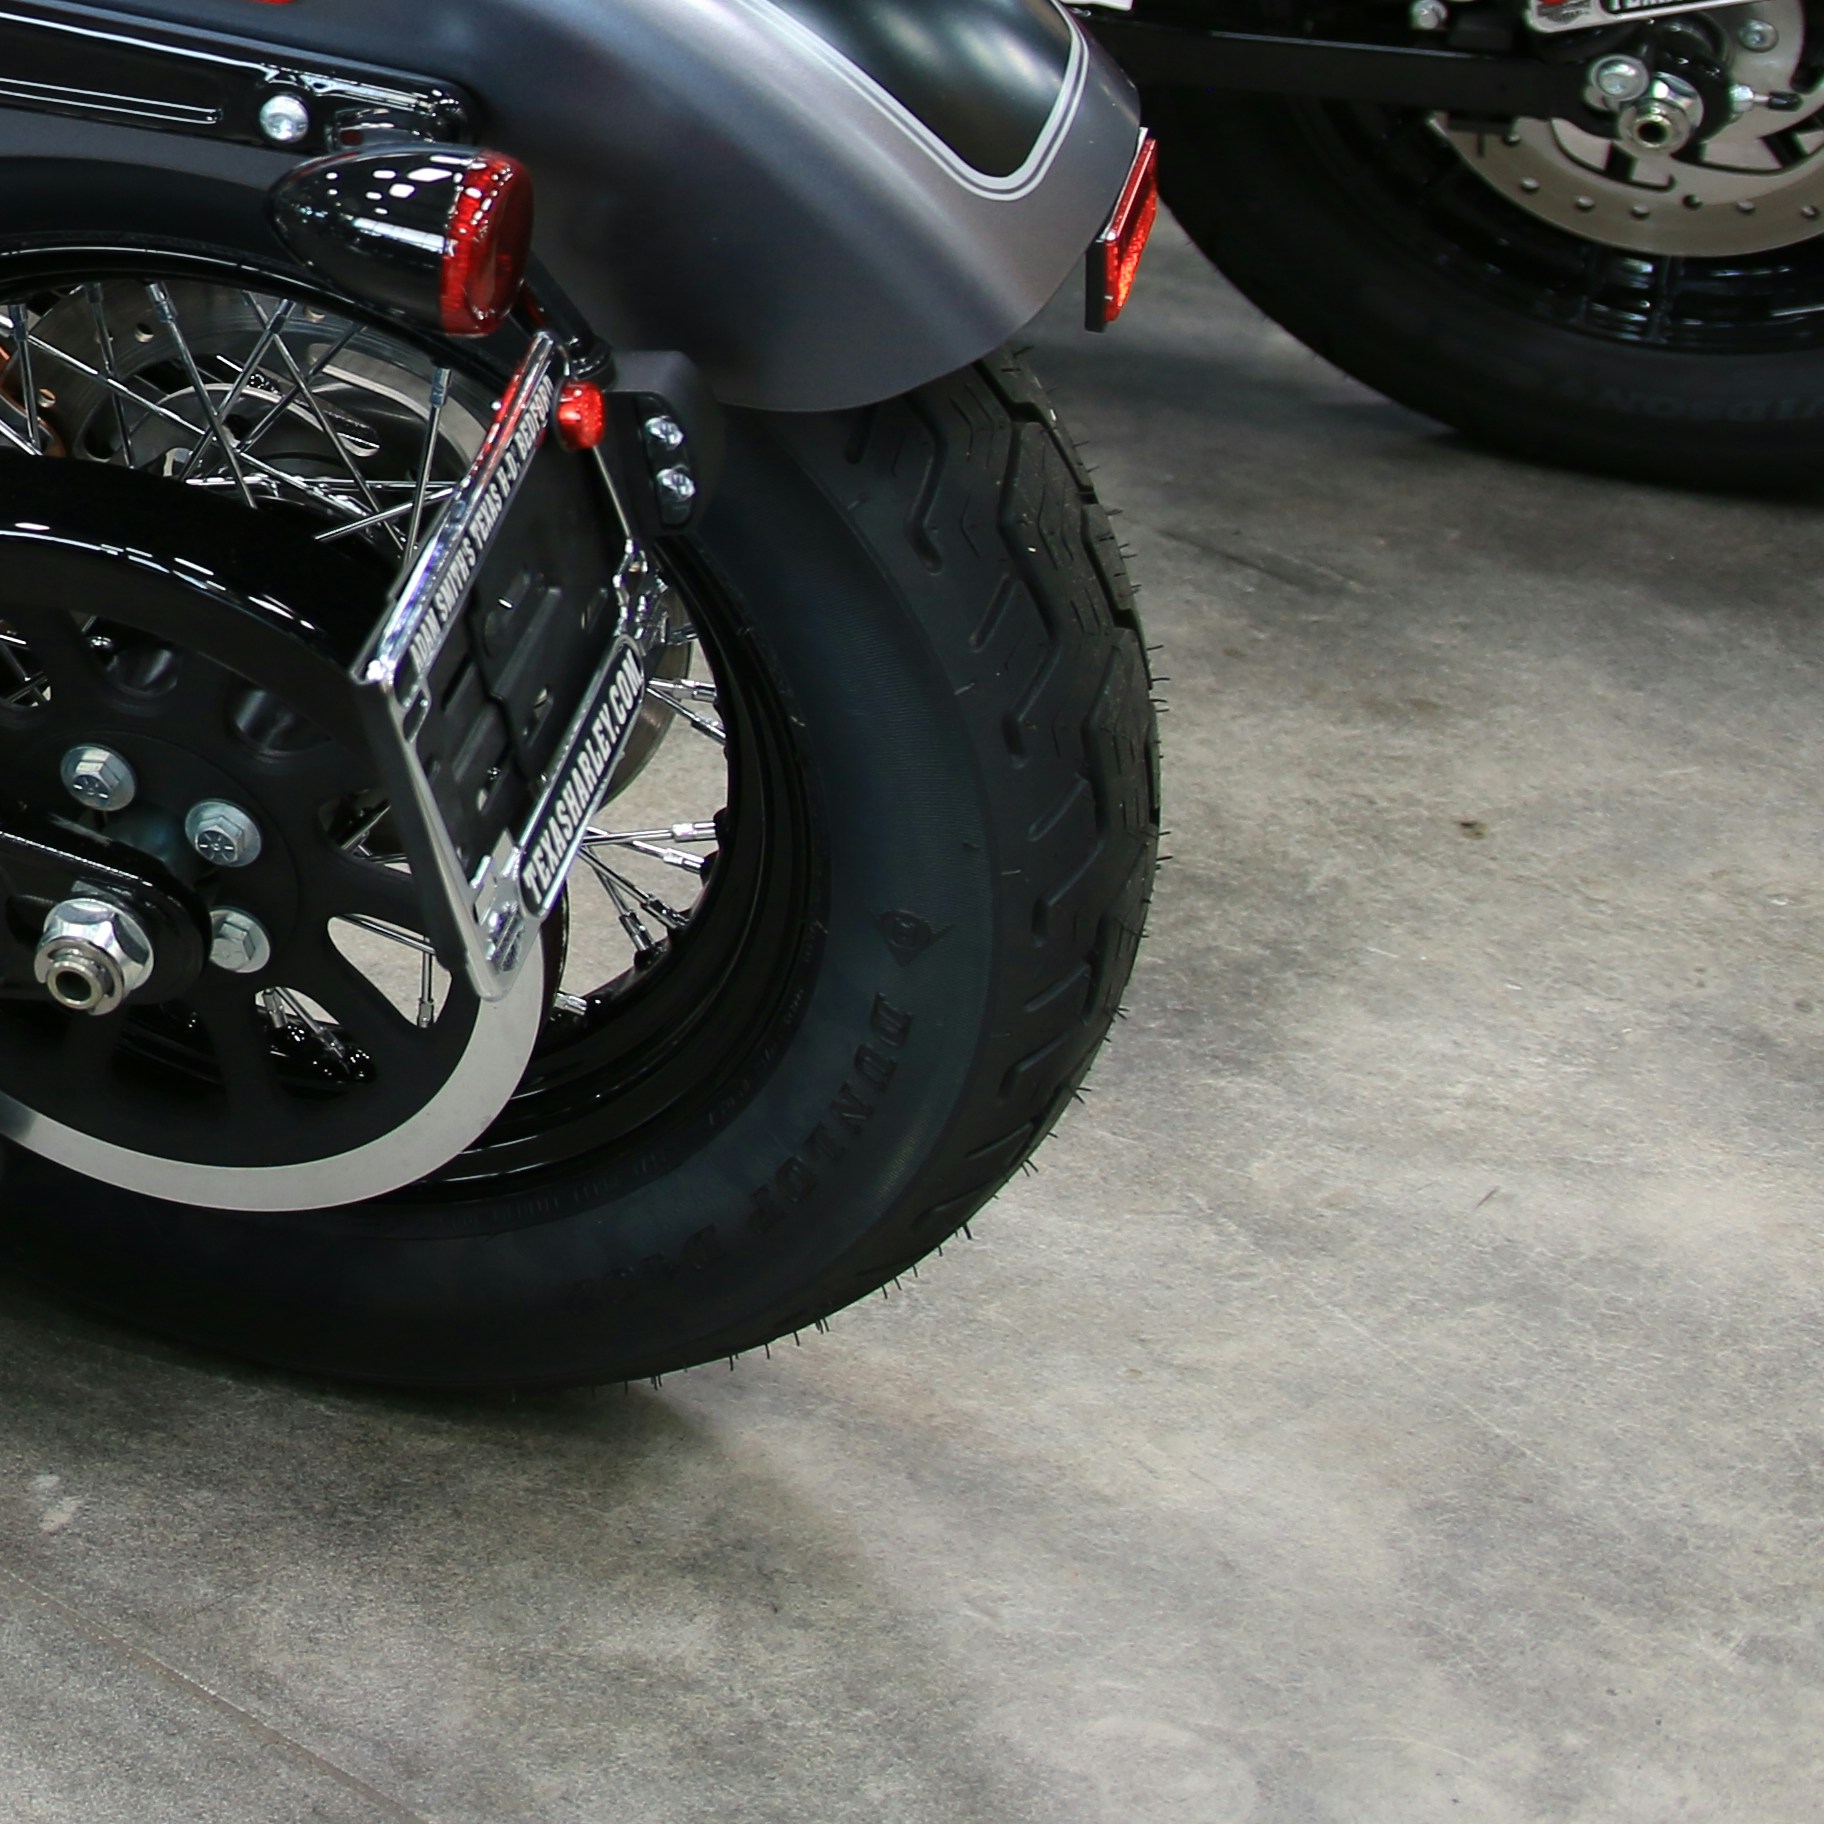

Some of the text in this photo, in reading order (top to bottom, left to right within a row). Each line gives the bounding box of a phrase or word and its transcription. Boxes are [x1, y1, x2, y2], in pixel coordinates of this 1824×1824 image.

[409, 619, 442, 675] ADAM
[433, 543, 477, 623] SMITH'S
[469, 482, 504, 552] TEXAS
[514, 374, 554, 464] BEDFORD
[521, 648, 645, 905] TEXASHARLEY.COM
[748, 990, 915, 1236] DUNLOP
